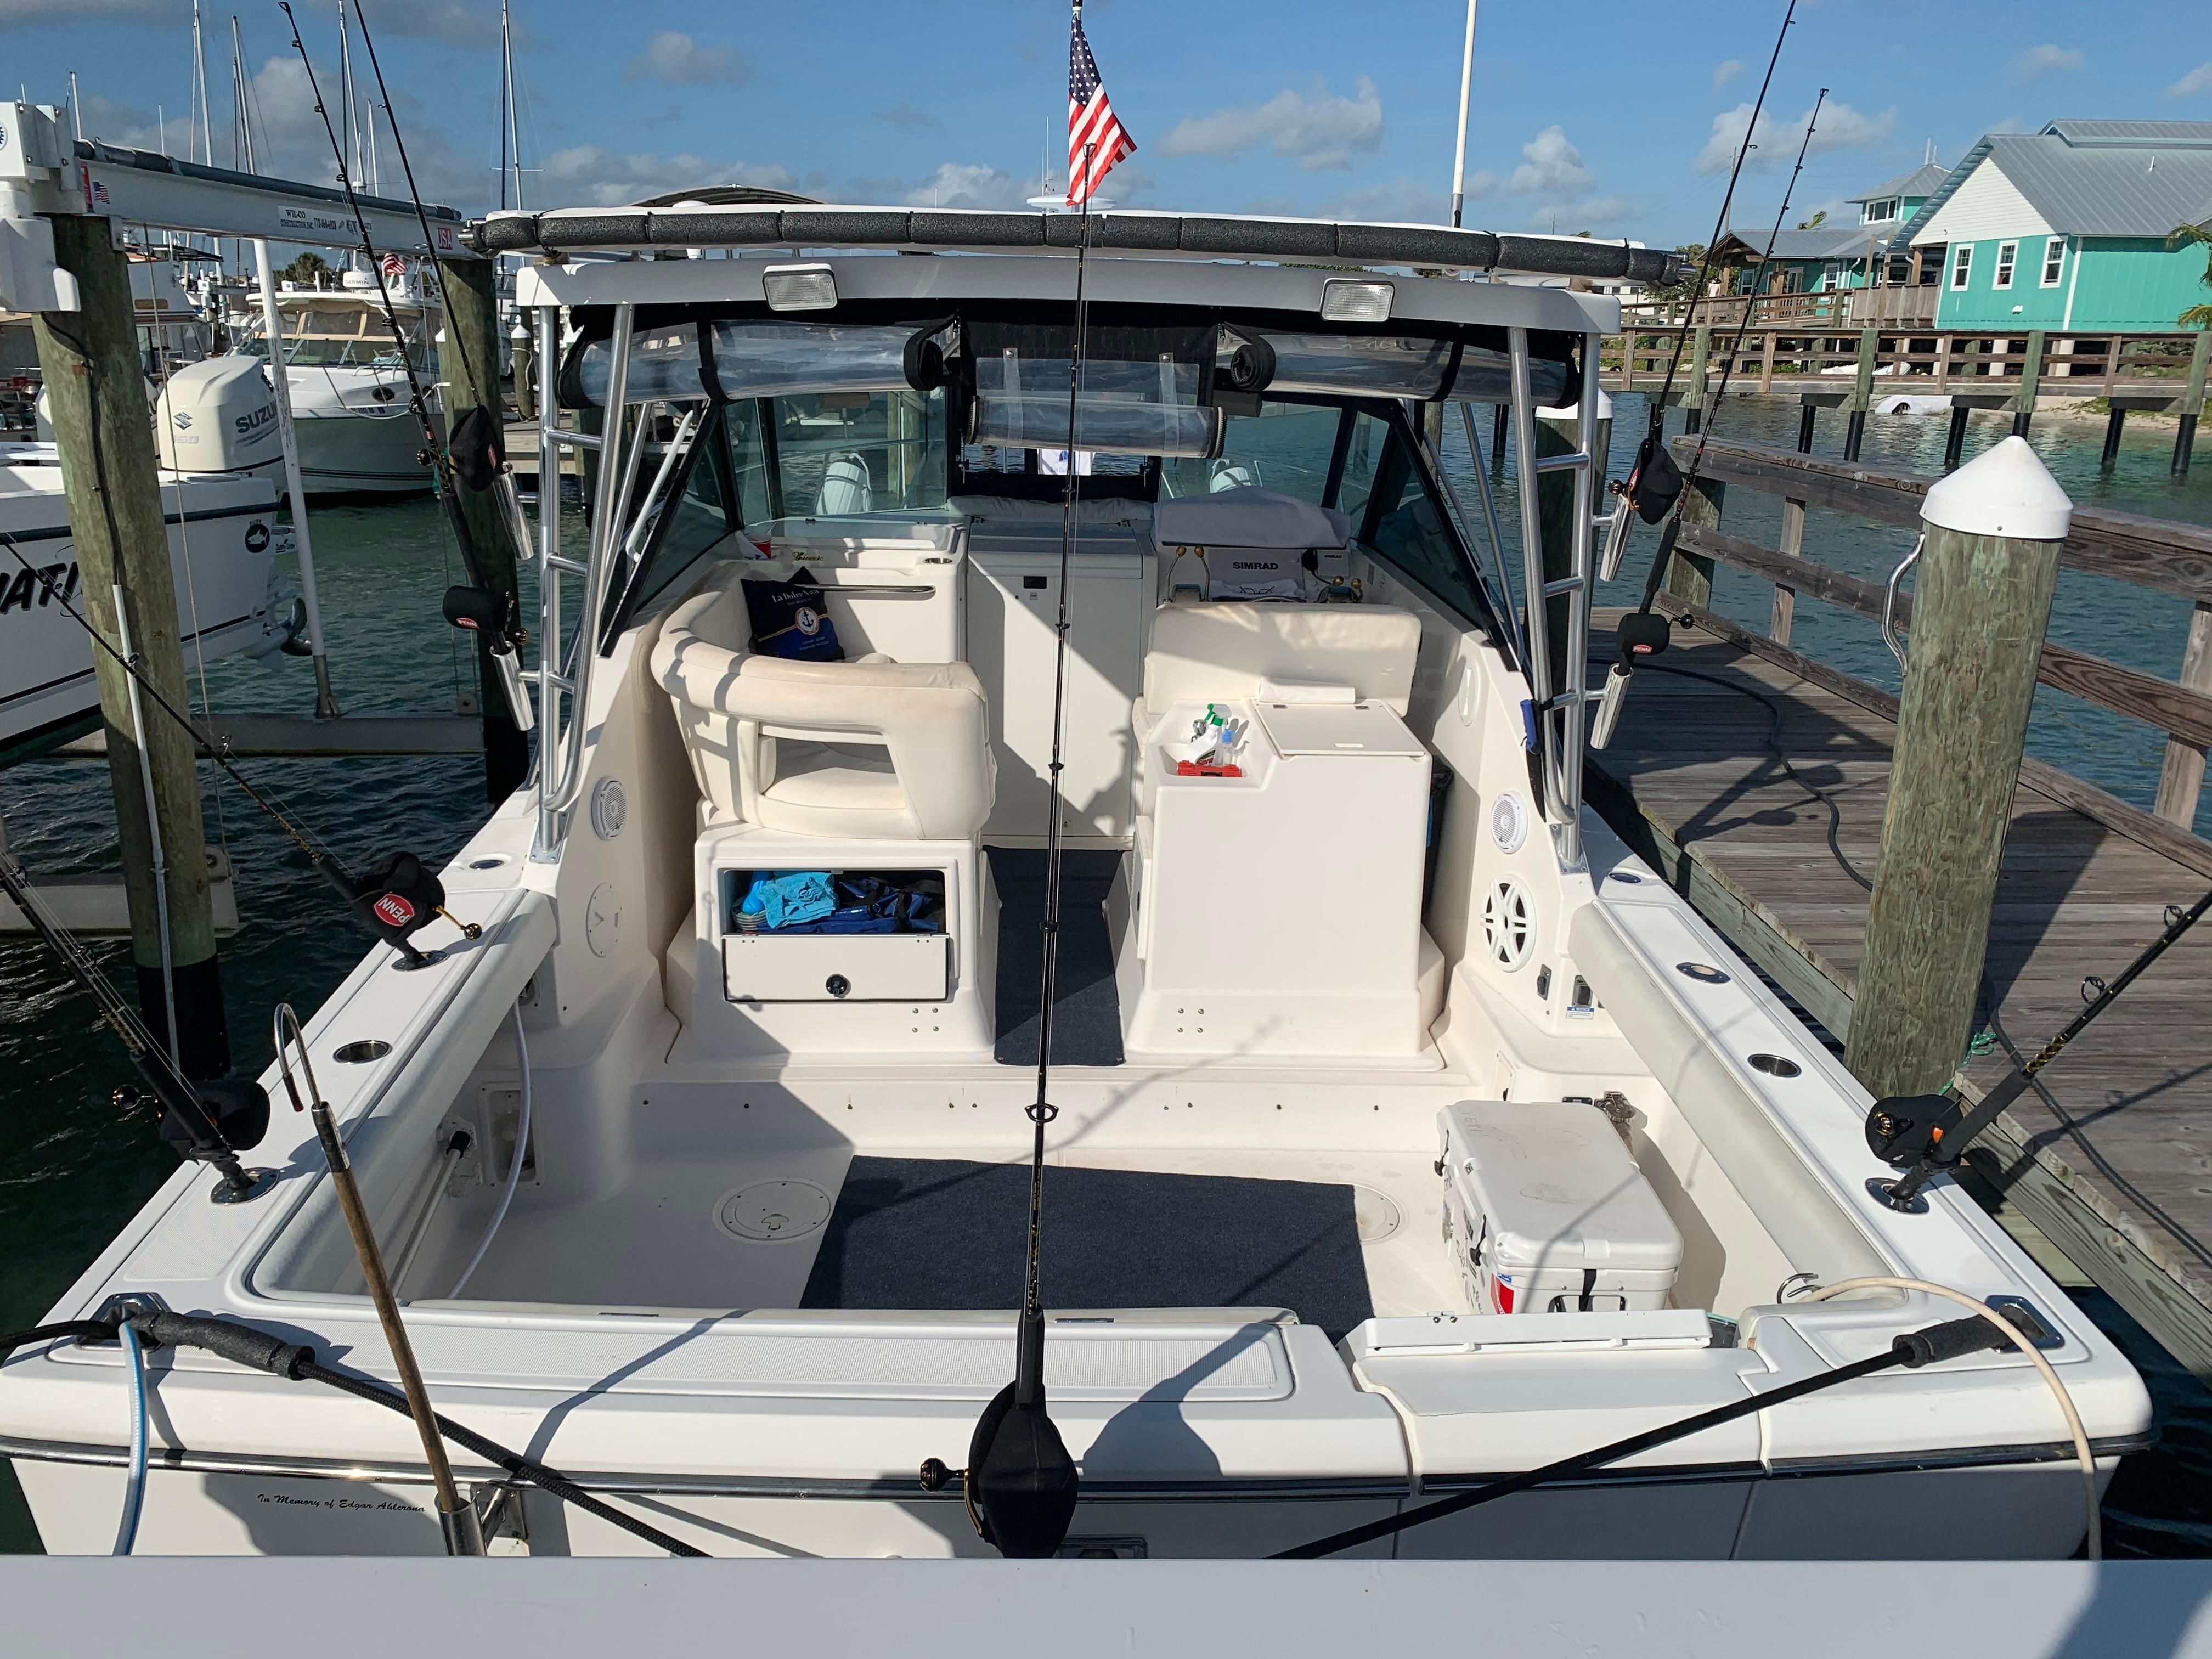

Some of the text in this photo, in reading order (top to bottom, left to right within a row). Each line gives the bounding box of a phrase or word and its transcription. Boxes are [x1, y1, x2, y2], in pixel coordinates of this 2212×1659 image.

[286, 210, 306, 219] WIL-CO
[437, 228, 453, 249] USA
[1233, 562, 1279, 571] SIMRAD
[378, 898, 410, 923] PENN
[257, 1493, 426, 1513] In Memory of Edgar Ahlcrona
